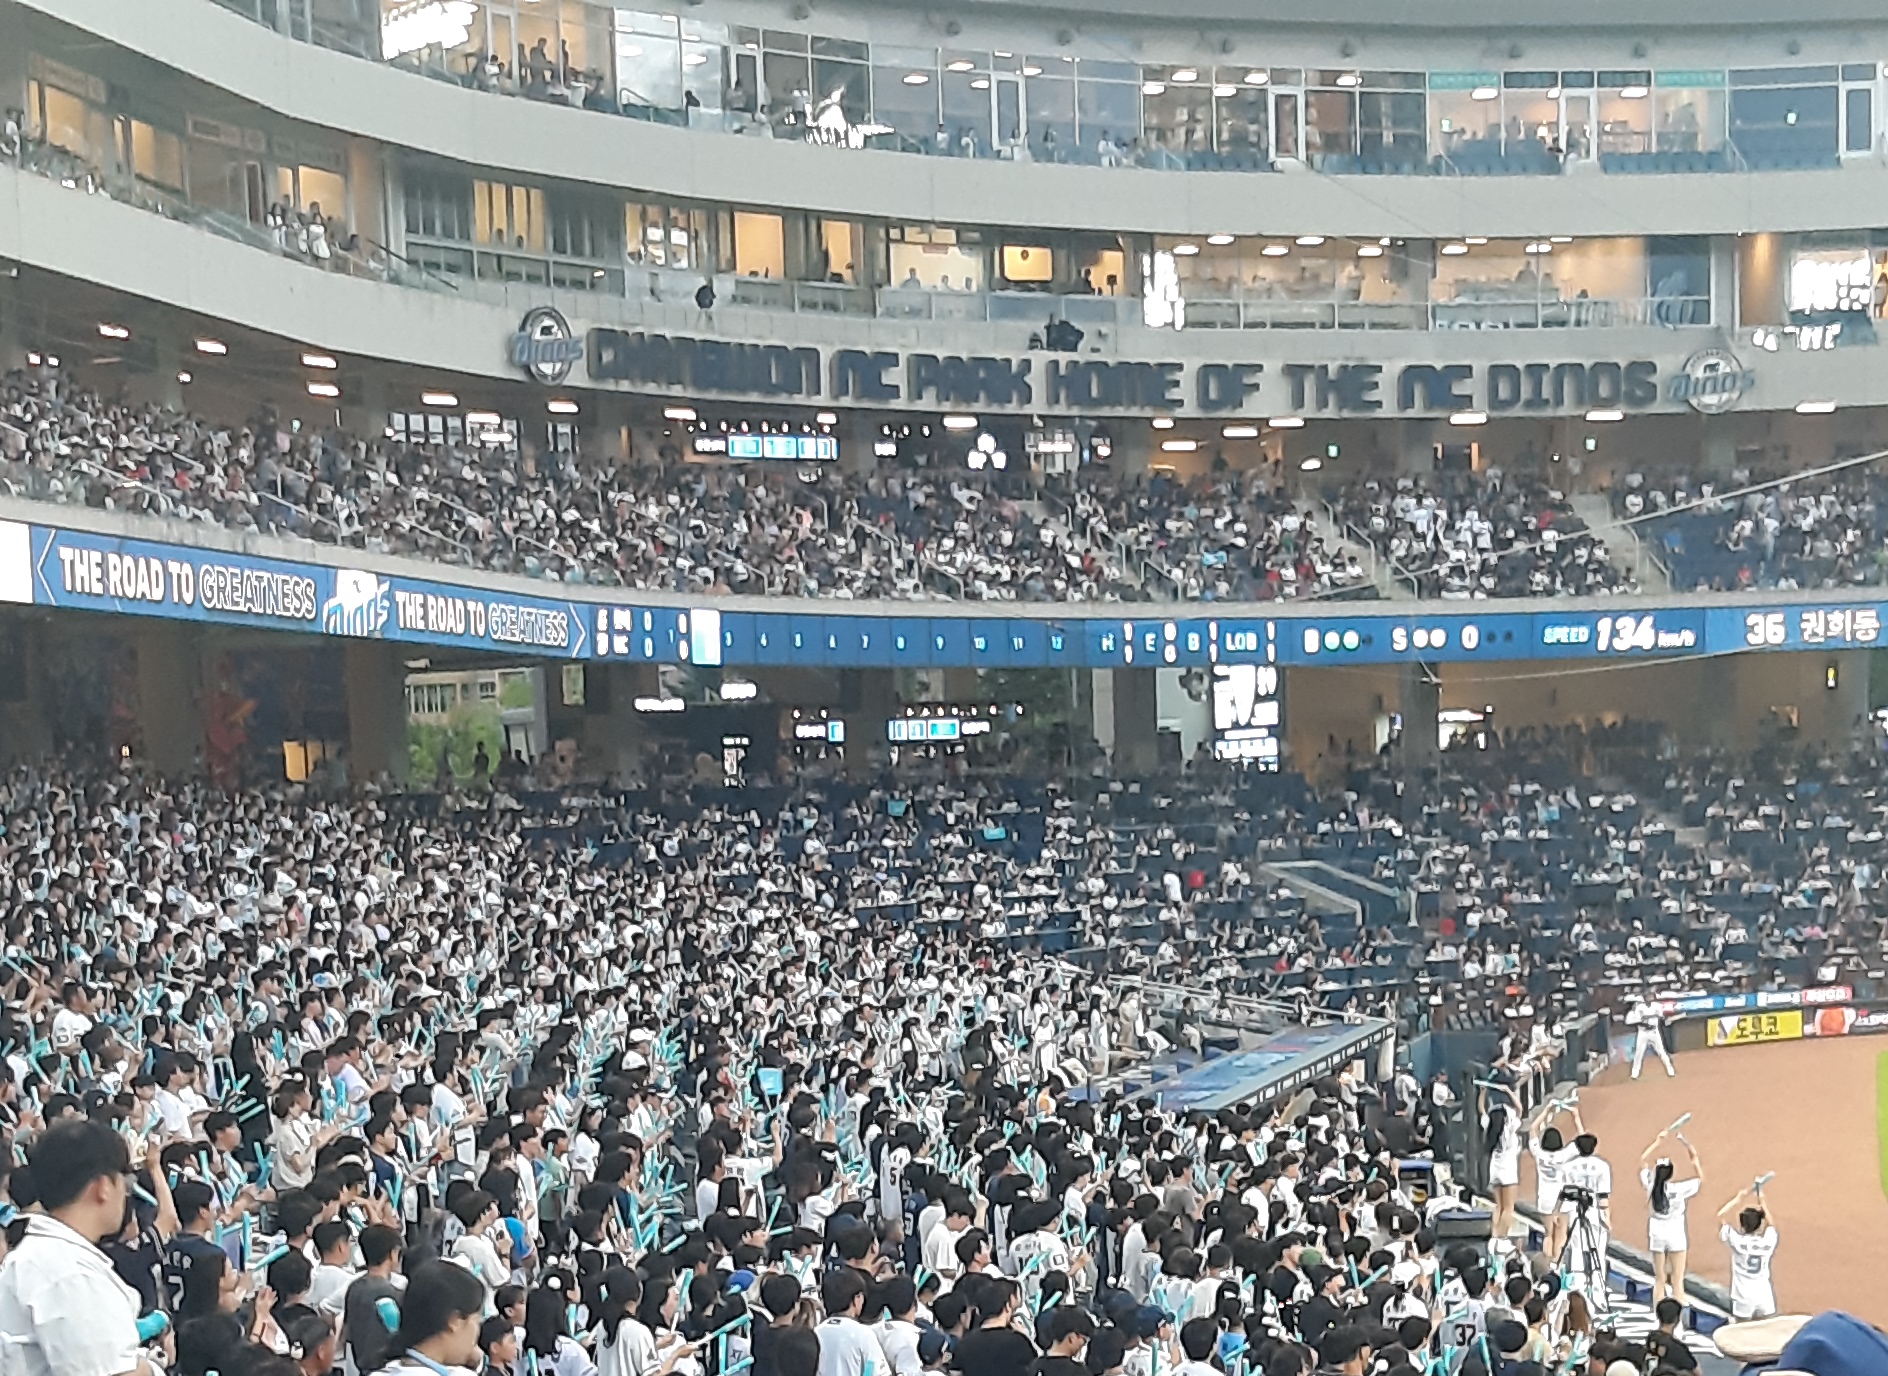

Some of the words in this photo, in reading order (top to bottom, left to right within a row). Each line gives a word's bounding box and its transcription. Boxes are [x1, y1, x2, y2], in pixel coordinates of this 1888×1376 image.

[908, 352, 1032, 403] PARK
[1046, 358, 1184, 409] HOME
[1196, 362, 1263, 410] OF
[1282, 363, 1383, 410] THE
[1397, 364, 1473, 410] NC
[1487, 361, 1658, 405] DINOS
[59, 547, 103, 595] THE
[106, 552, 164, 601] ROAD
[168, 559, 194, 604] TO
[199, 565, 316, 619] GREATNESS
[395, 591, 426, 632] THE
[428, 593, 465, 636] ROAD
[467, 600, 485, 637] TO
[488, 603, 568, 647] GREATNESS
[1543, 624, 1590, 645] SPEED
[1596, 614, 1656, 651] 134
[1745, 612, 1785, 645] 36
[1799, 609, 1881, 643] 권희동
[1455, 1324, 1479, 1346] 37
